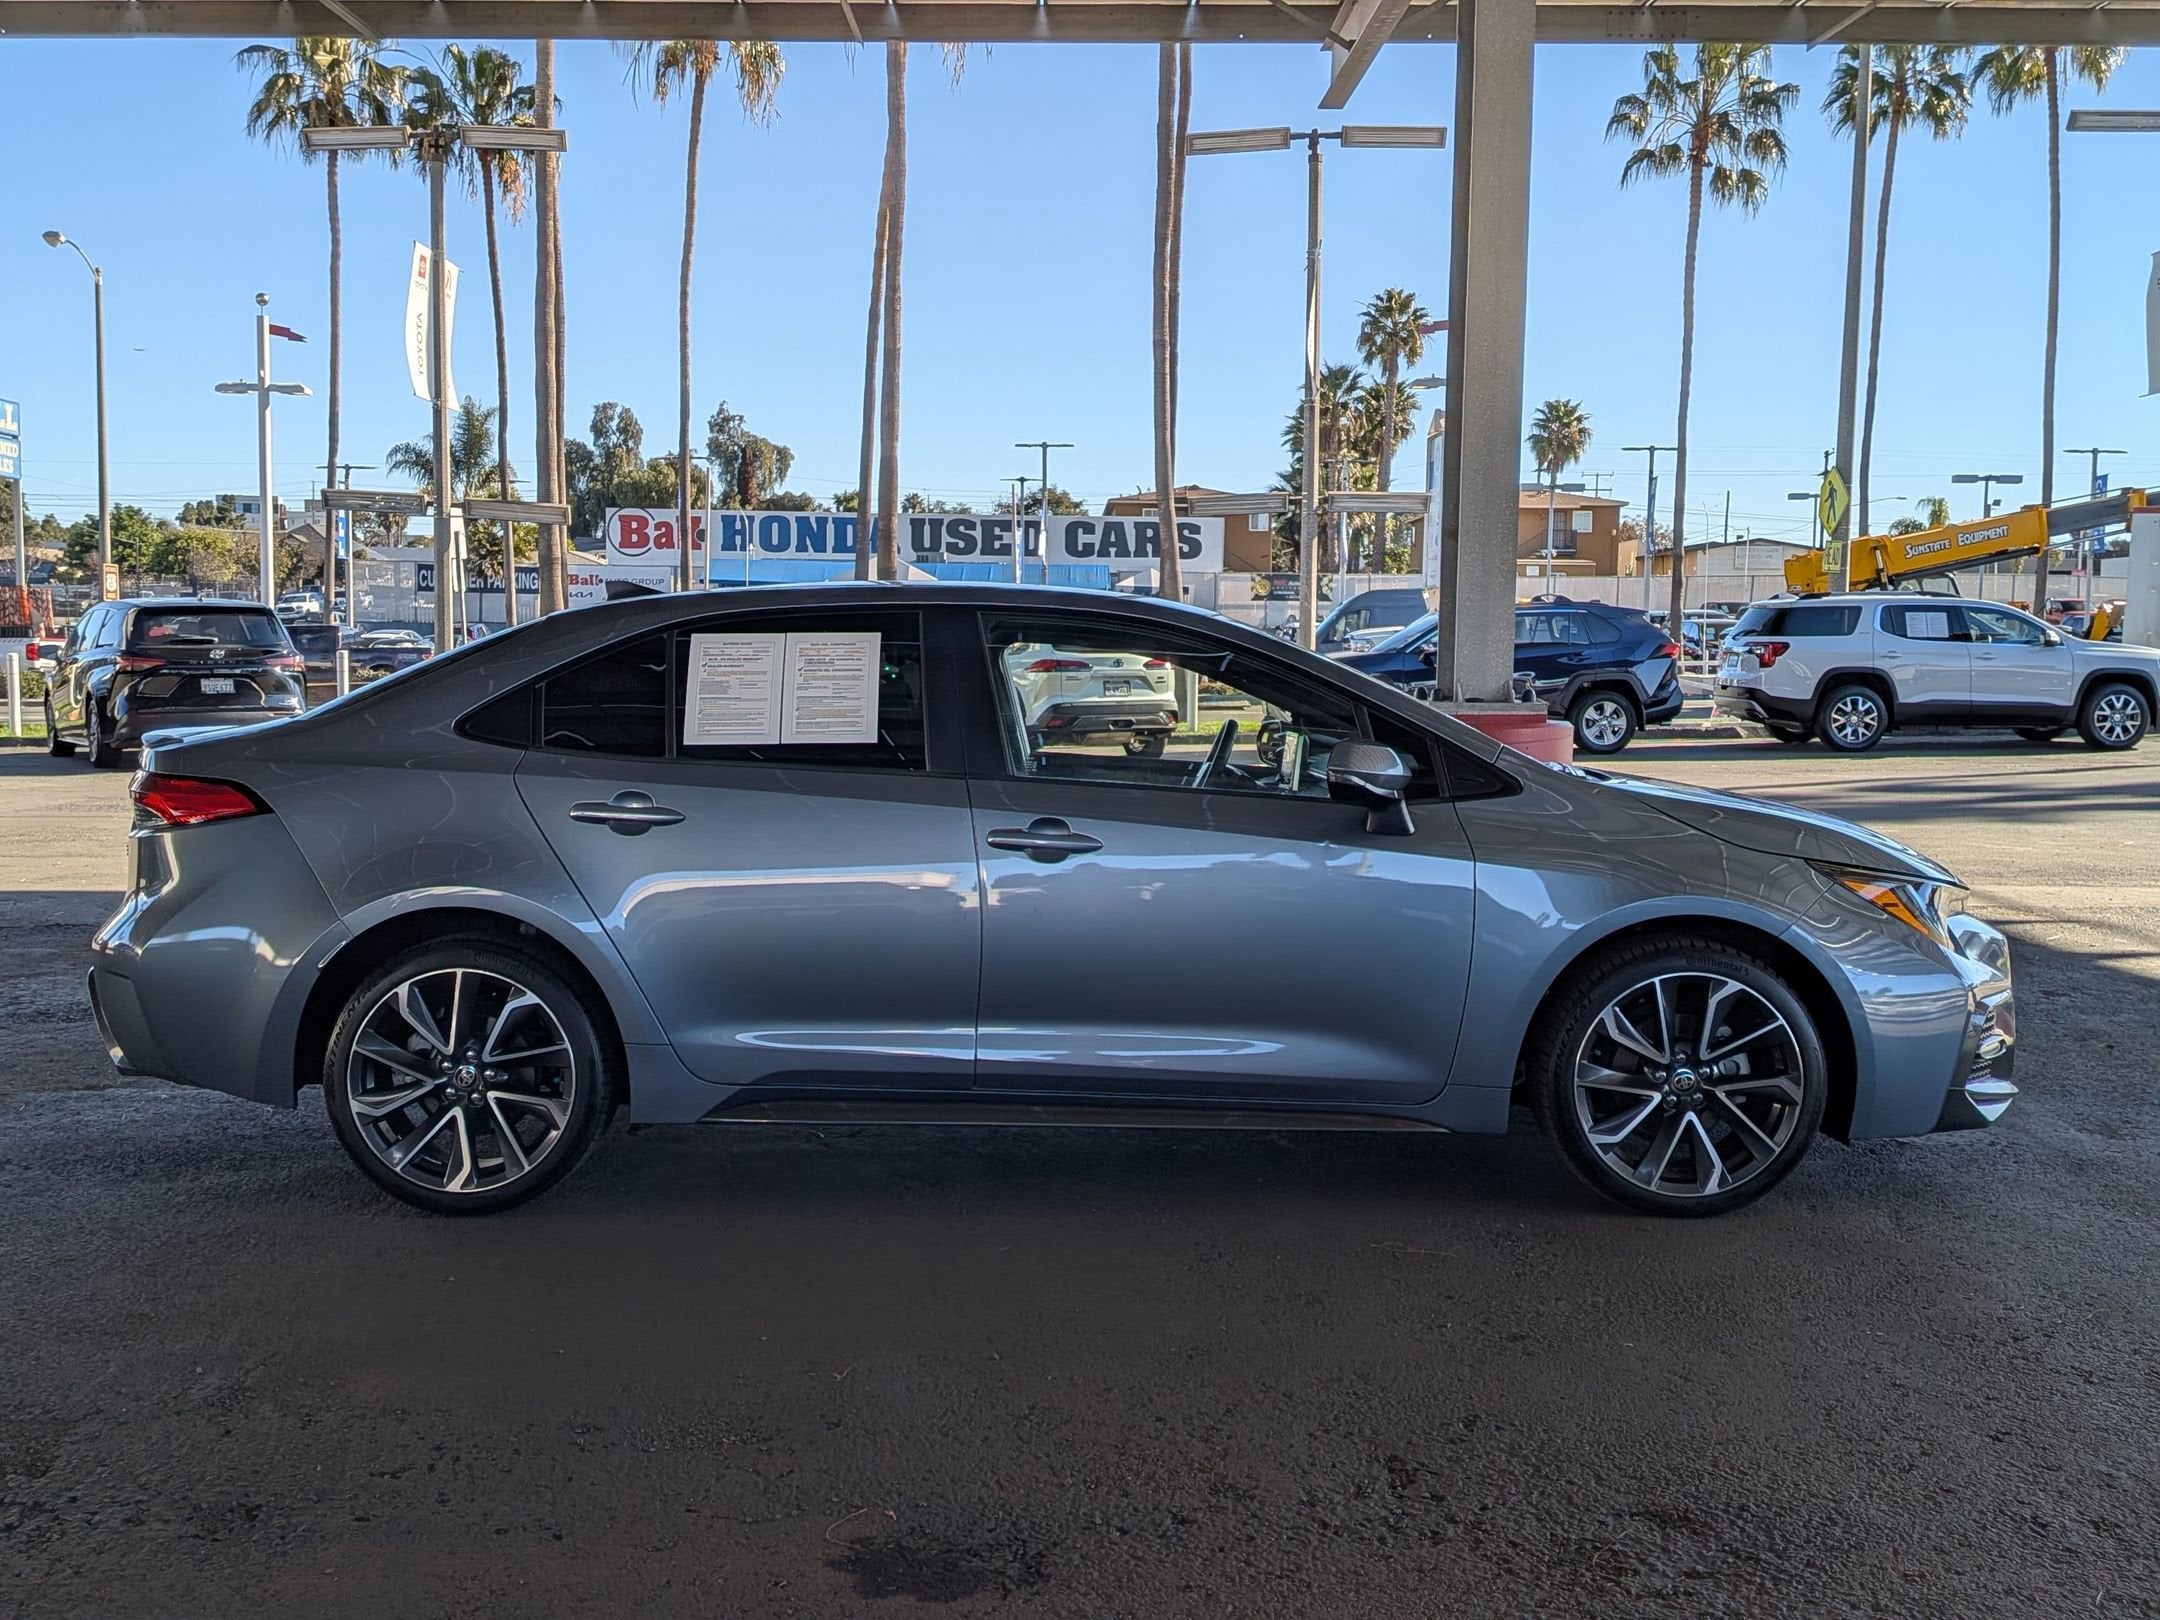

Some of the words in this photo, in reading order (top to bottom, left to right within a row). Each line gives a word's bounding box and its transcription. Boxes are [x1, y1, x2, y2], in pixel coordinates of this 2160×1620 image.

[415, 312, 424, 377] TOYOTA
[1064, 520, 1203, 560] CARS
[568, 573, 600, 587] Ball
[631, 578, 665, 586] GROUP
